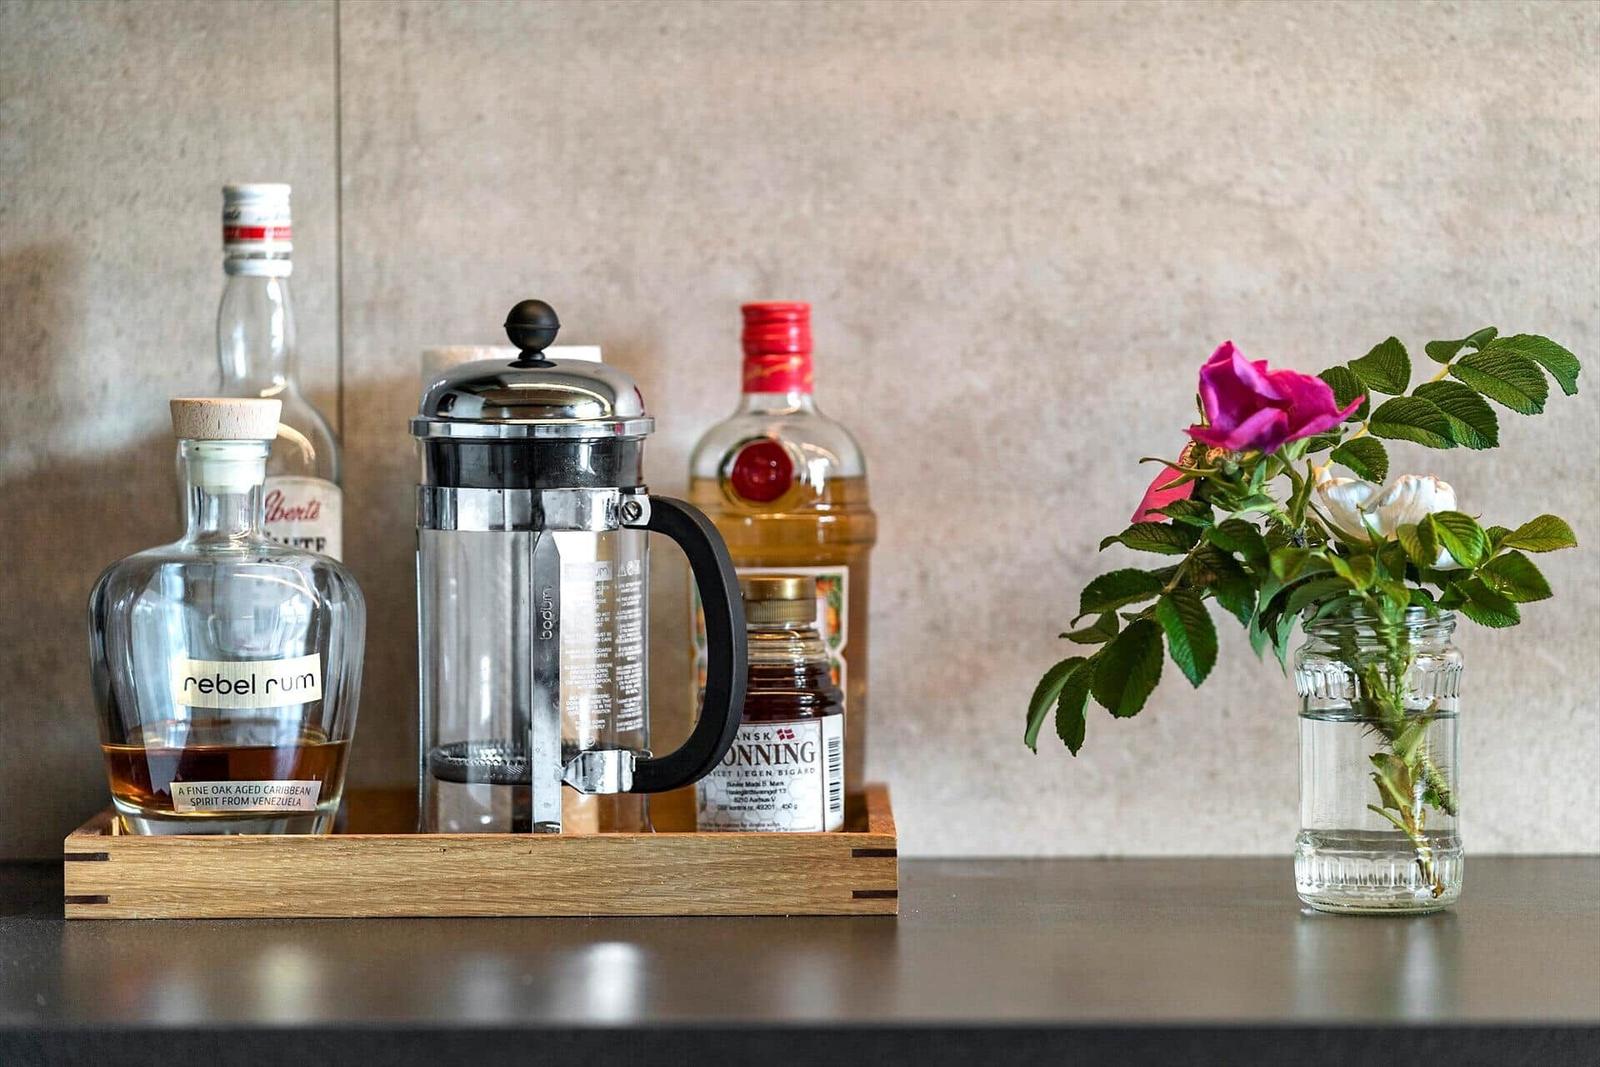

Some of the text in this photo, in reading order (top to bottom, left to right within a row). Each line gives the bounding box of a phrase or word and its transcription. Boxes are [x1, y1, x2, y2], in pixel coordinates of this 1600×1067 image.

[540, 584, 553, 640] bodum
[184, 673, 315, 695] rebel rum
[736, 733, 771, 741] ANSK
[722, 741, 816, 766] ONNING
[744, 769, 773, 777] EGEN
[178, 785, 311, 795] A FINE OAK AGED CARIBBEAN
[190, 796, 301, 806] SPIRIT FROM VENEZUELA
